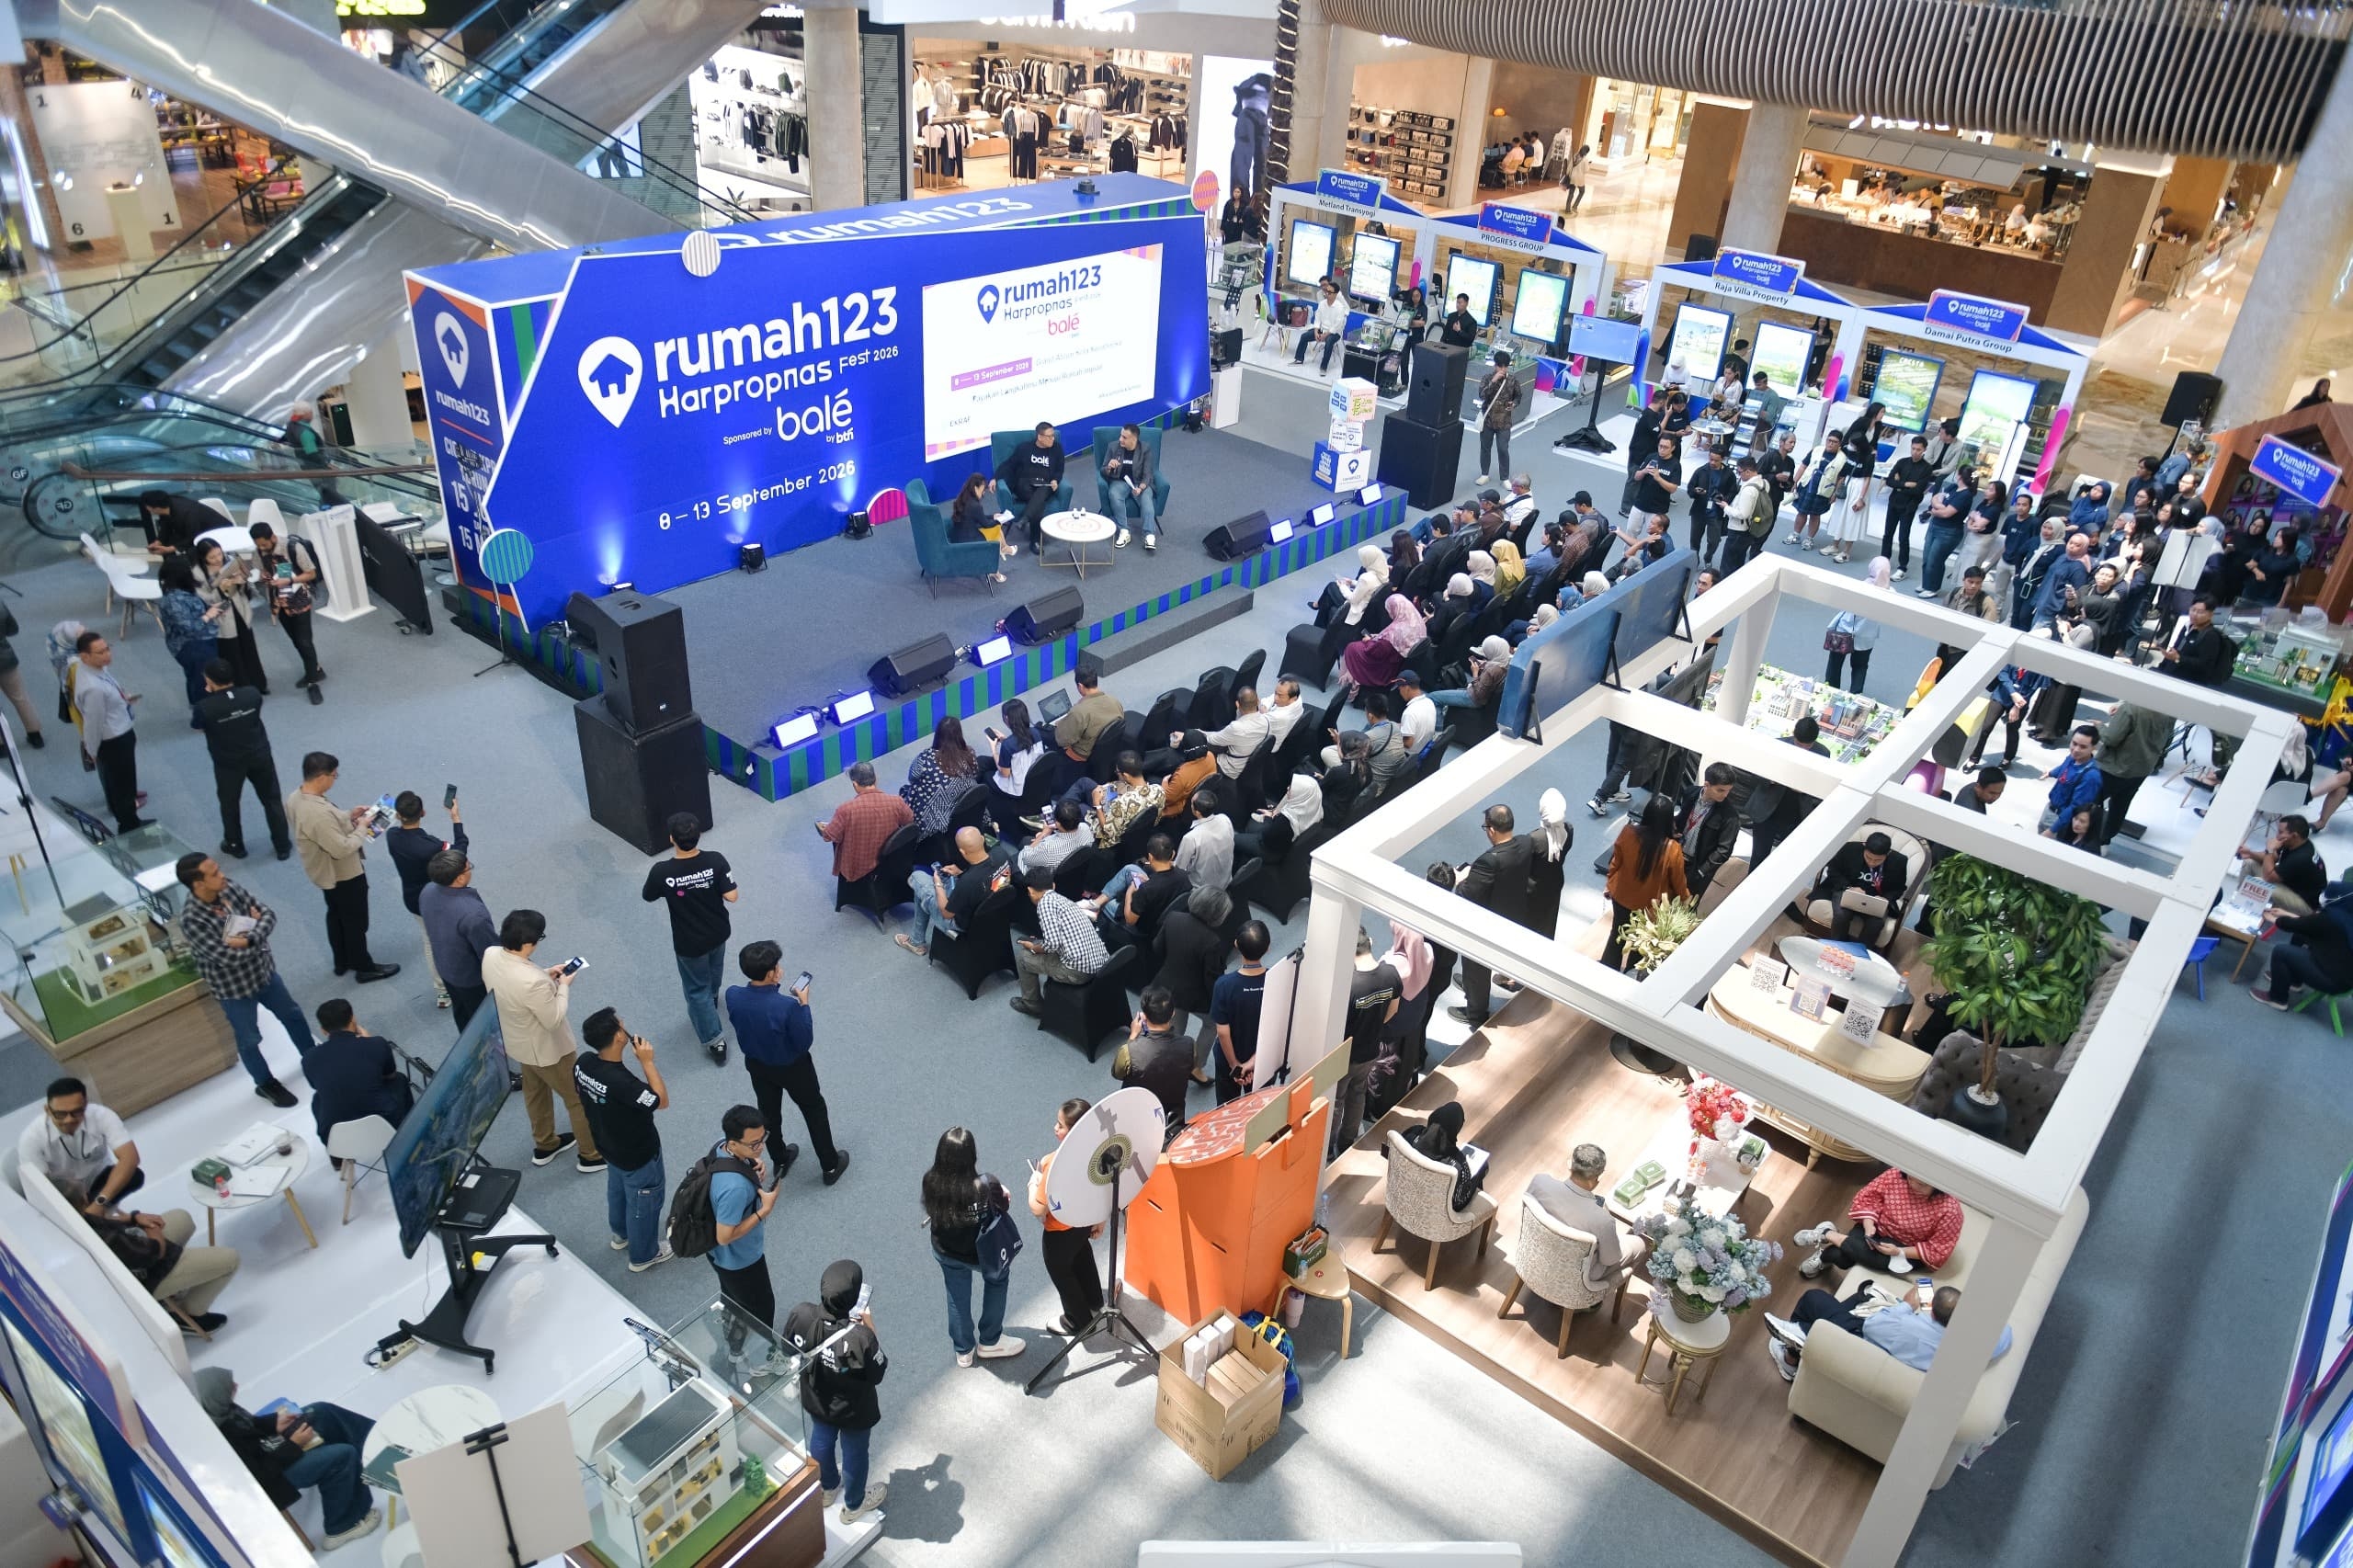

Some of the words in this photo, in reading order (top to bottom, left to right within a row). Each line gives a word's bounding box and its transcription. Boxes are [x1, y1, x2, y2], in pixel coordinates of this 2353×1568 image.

[1337, 177, 1369, 189] rumah123
[1318, 199, 1345, 210] Metland
[1346, 204, 1376, 218] Transyogi
[1503, 211, 1537, 224] rumah123
[72, 222, 84, 235] 6
[765, 197, 1032, 244] rumah123
[1481, 233, 1518, 247] PROGRESS
[1518, 241, 1544, 252] GROUP
[1742, 258, 1782, 273] rumah123
[1005, 265, 1102, 304] rumah123
[1714, 282, 1732, 292] Raja
[1733, 286, 1751, 296] Villa
[1753, 290, 1789, 305] Property
[1004, 298, 1073, 321] Harpropnas
[1960, 302, 2005, 319] rumah123
[654, 286, 898, 382] rumah123
[1048, 313, 1080, 335] balé
[1925, 326, 1955, 340] Damai
[1956, 332, 1981, 346] Putra
[1983, 339, 2013, 353] Group
[658, 360, 833, 418] Harpropnas
[839, 348, 871, 374] Fest
[873, 346, 899, 362] 2026
[981, 366, 1014, 381] September
[436, 390, 491, 426] rumah123
[722, 428, 763, 445] Sponsored
[763, 426, 773, 437] by
[776, 388, 853, 441] balé
[826, 435, 835, 444] by
[12, 469, 27, 479] GF
[2281, 451, 2321, 478] rumah123
[451, 481, 470, 513] 15
[659, 513, 671, 530] 8
[693, 501, 710, 521] 13
[717, 475, 813, 514] September
[818, 460, 856, 484] 2026
[459, 525, 473, 551] 15
[2244, 882, 2269, 896] FREE
